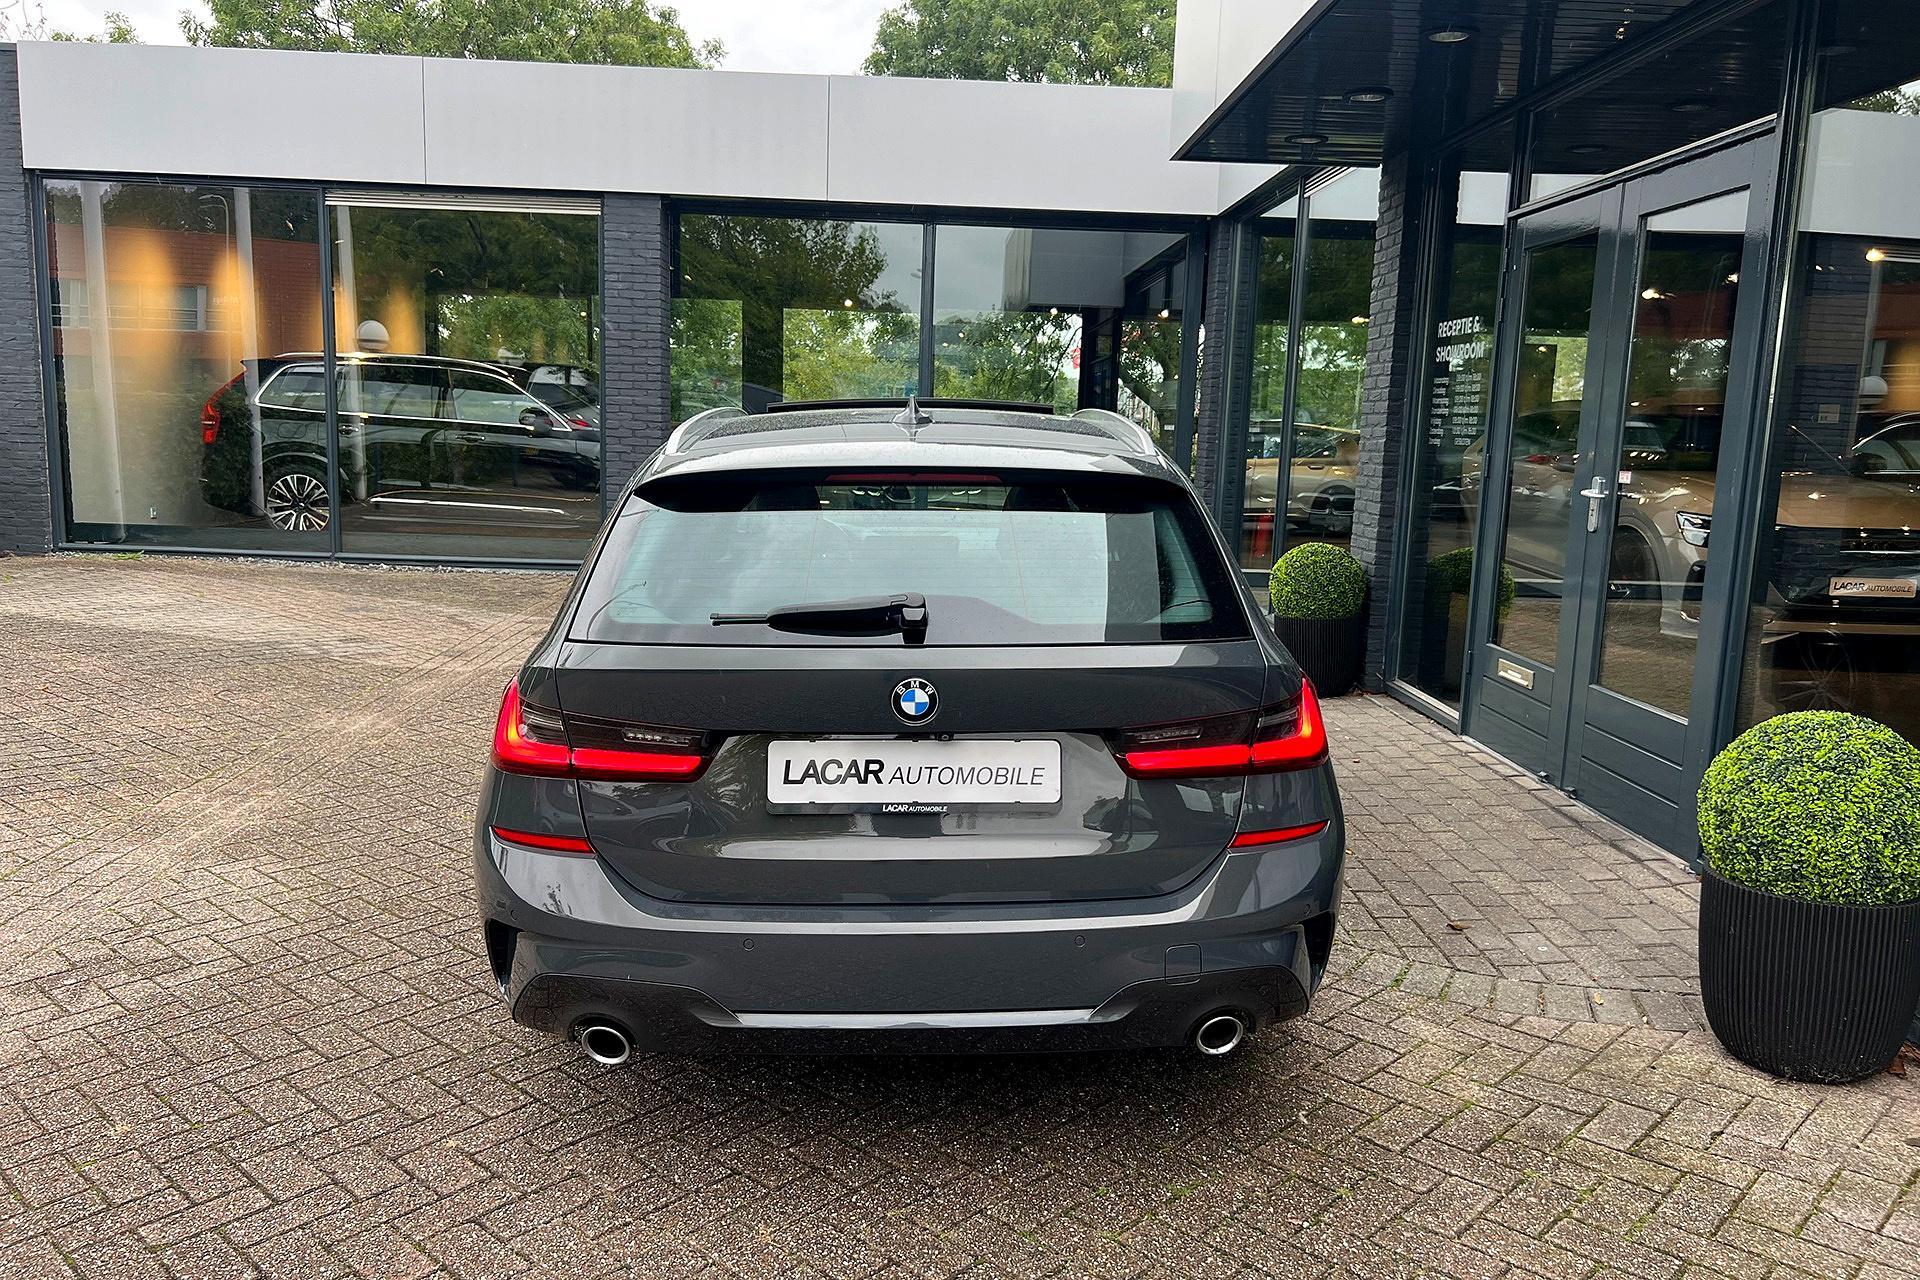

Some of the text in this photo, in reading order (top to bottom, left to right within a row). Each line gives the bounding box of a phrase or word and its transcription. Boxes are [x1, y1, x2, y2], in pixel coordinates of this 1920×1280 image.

[1438, 316, 1473, 338] RECEPTIE
[1435, 341, 1486, 362] SHOWROOM
[1833, 581, 1913, 593] LACAR AUTOMOBILE
[896, 680, 935, 696] BMW
[782, 759, 1046, 785] LACAR AUTOMOBILE
[882, 804, 909, 812] LACAR
